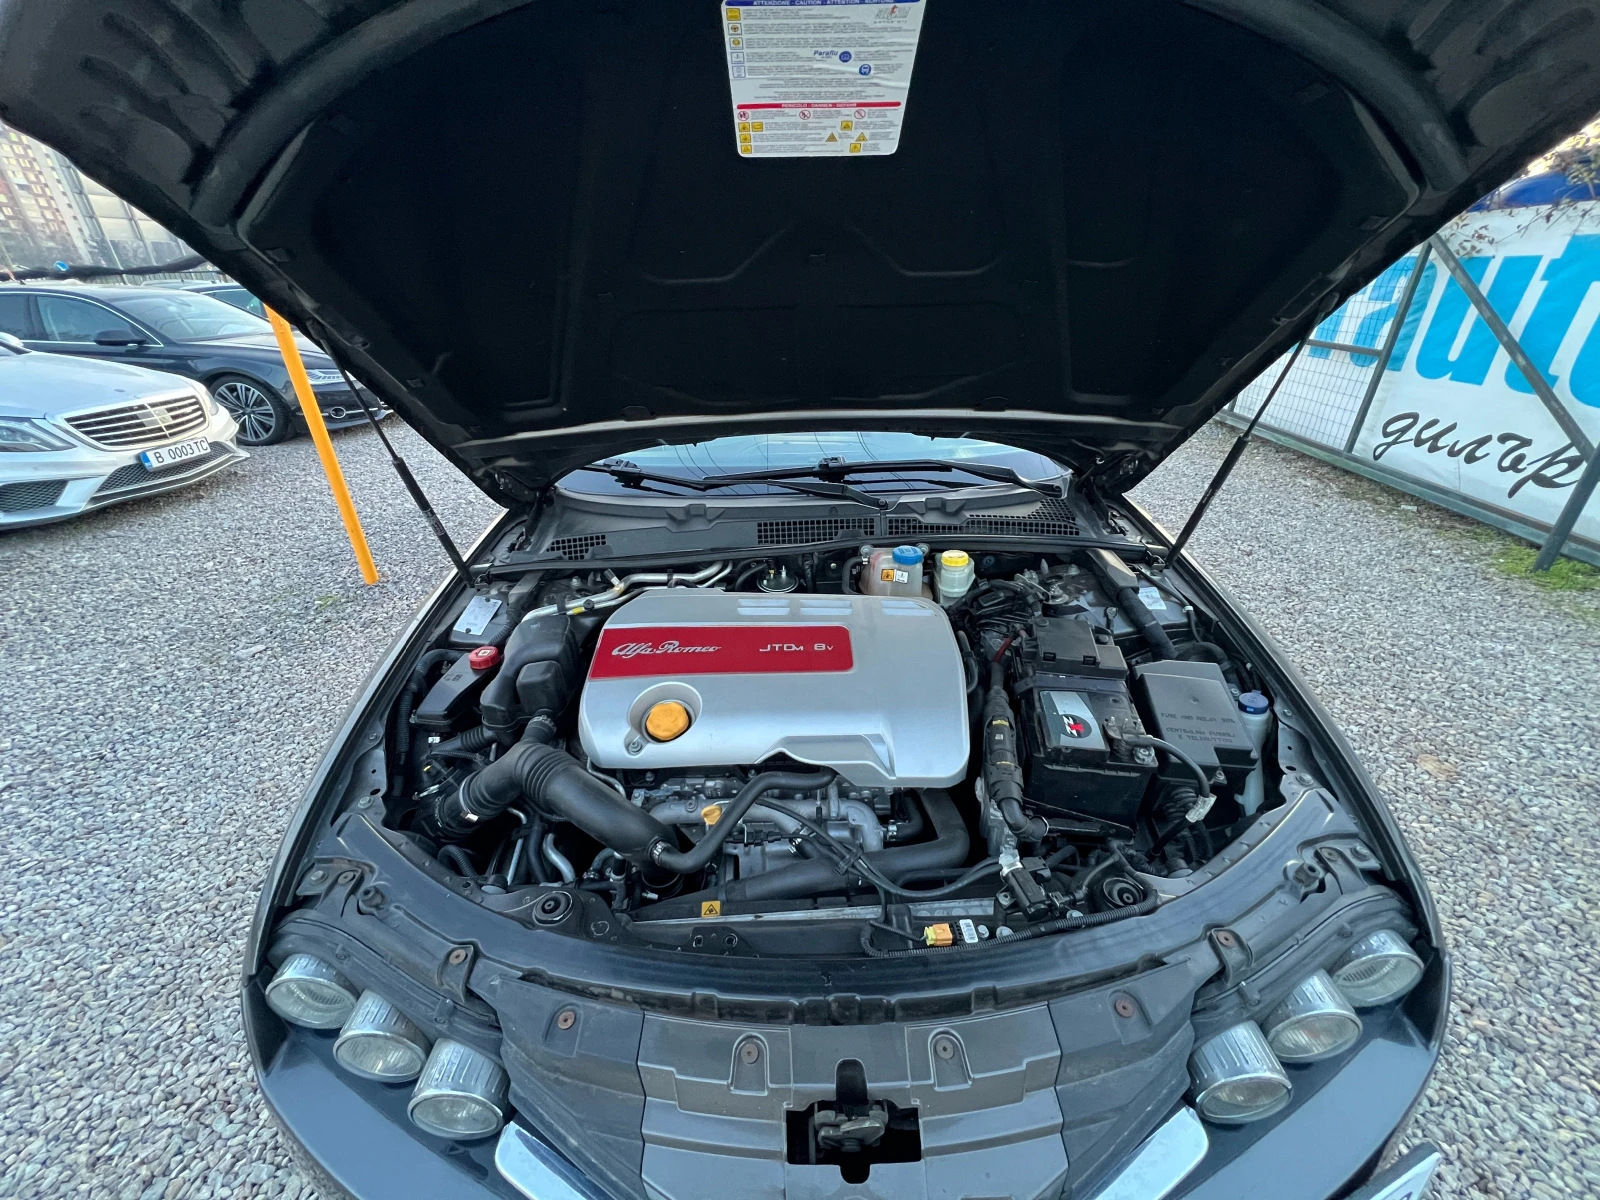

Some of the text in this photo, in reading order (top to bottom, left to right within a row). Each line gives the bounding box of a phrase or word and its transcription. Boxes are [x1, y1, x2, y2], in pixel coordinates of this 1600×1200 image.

[154, 440, 208, 463] B 0003 TC
[611, 640, 722, 659] Alfa Romeo
